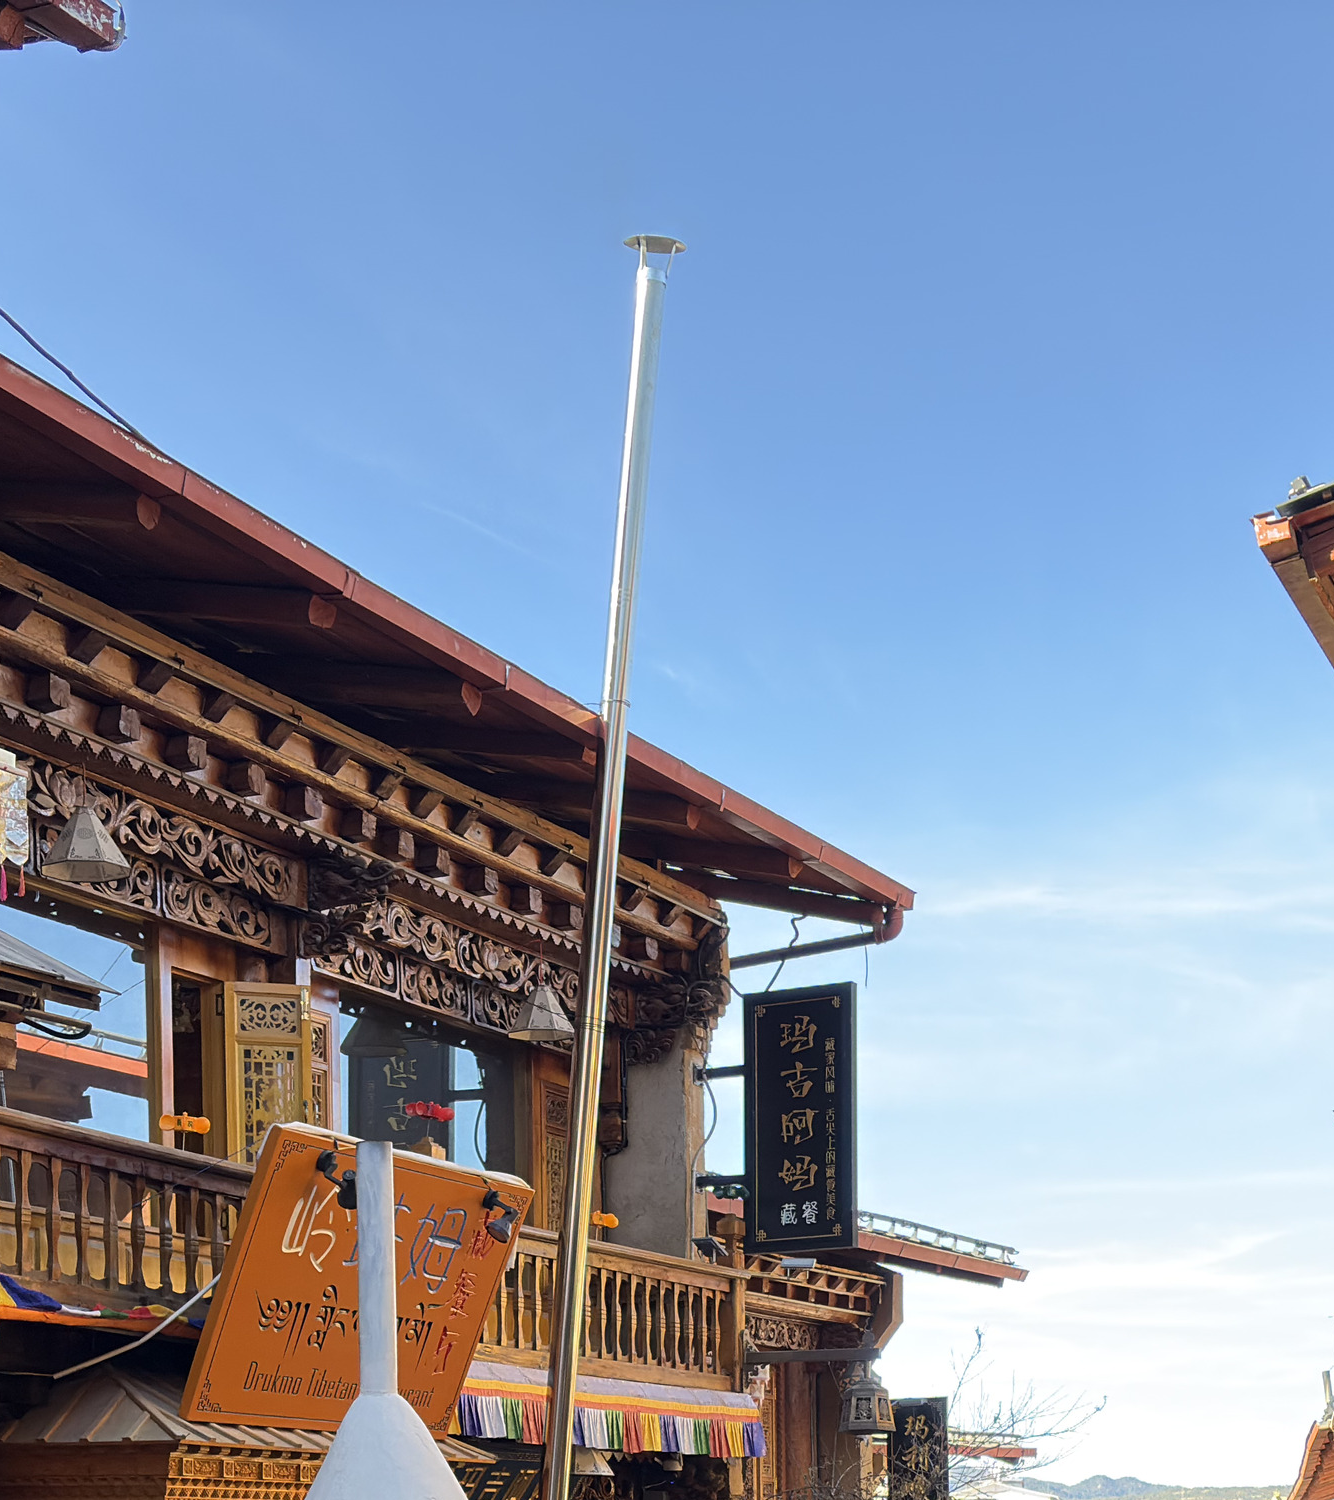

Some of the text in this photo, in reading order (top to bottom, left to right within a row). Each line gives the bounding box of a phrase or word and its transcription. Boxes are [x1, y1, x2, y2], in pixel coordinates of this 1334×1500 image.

[778, 1014, 820, 1193] 玛吉阿妈
[779, 1200, 819, 1227] 藏餐
[243, 1360, 303, 1396] Drukmo
[306, 1367, 357, 1400] Tibetan
